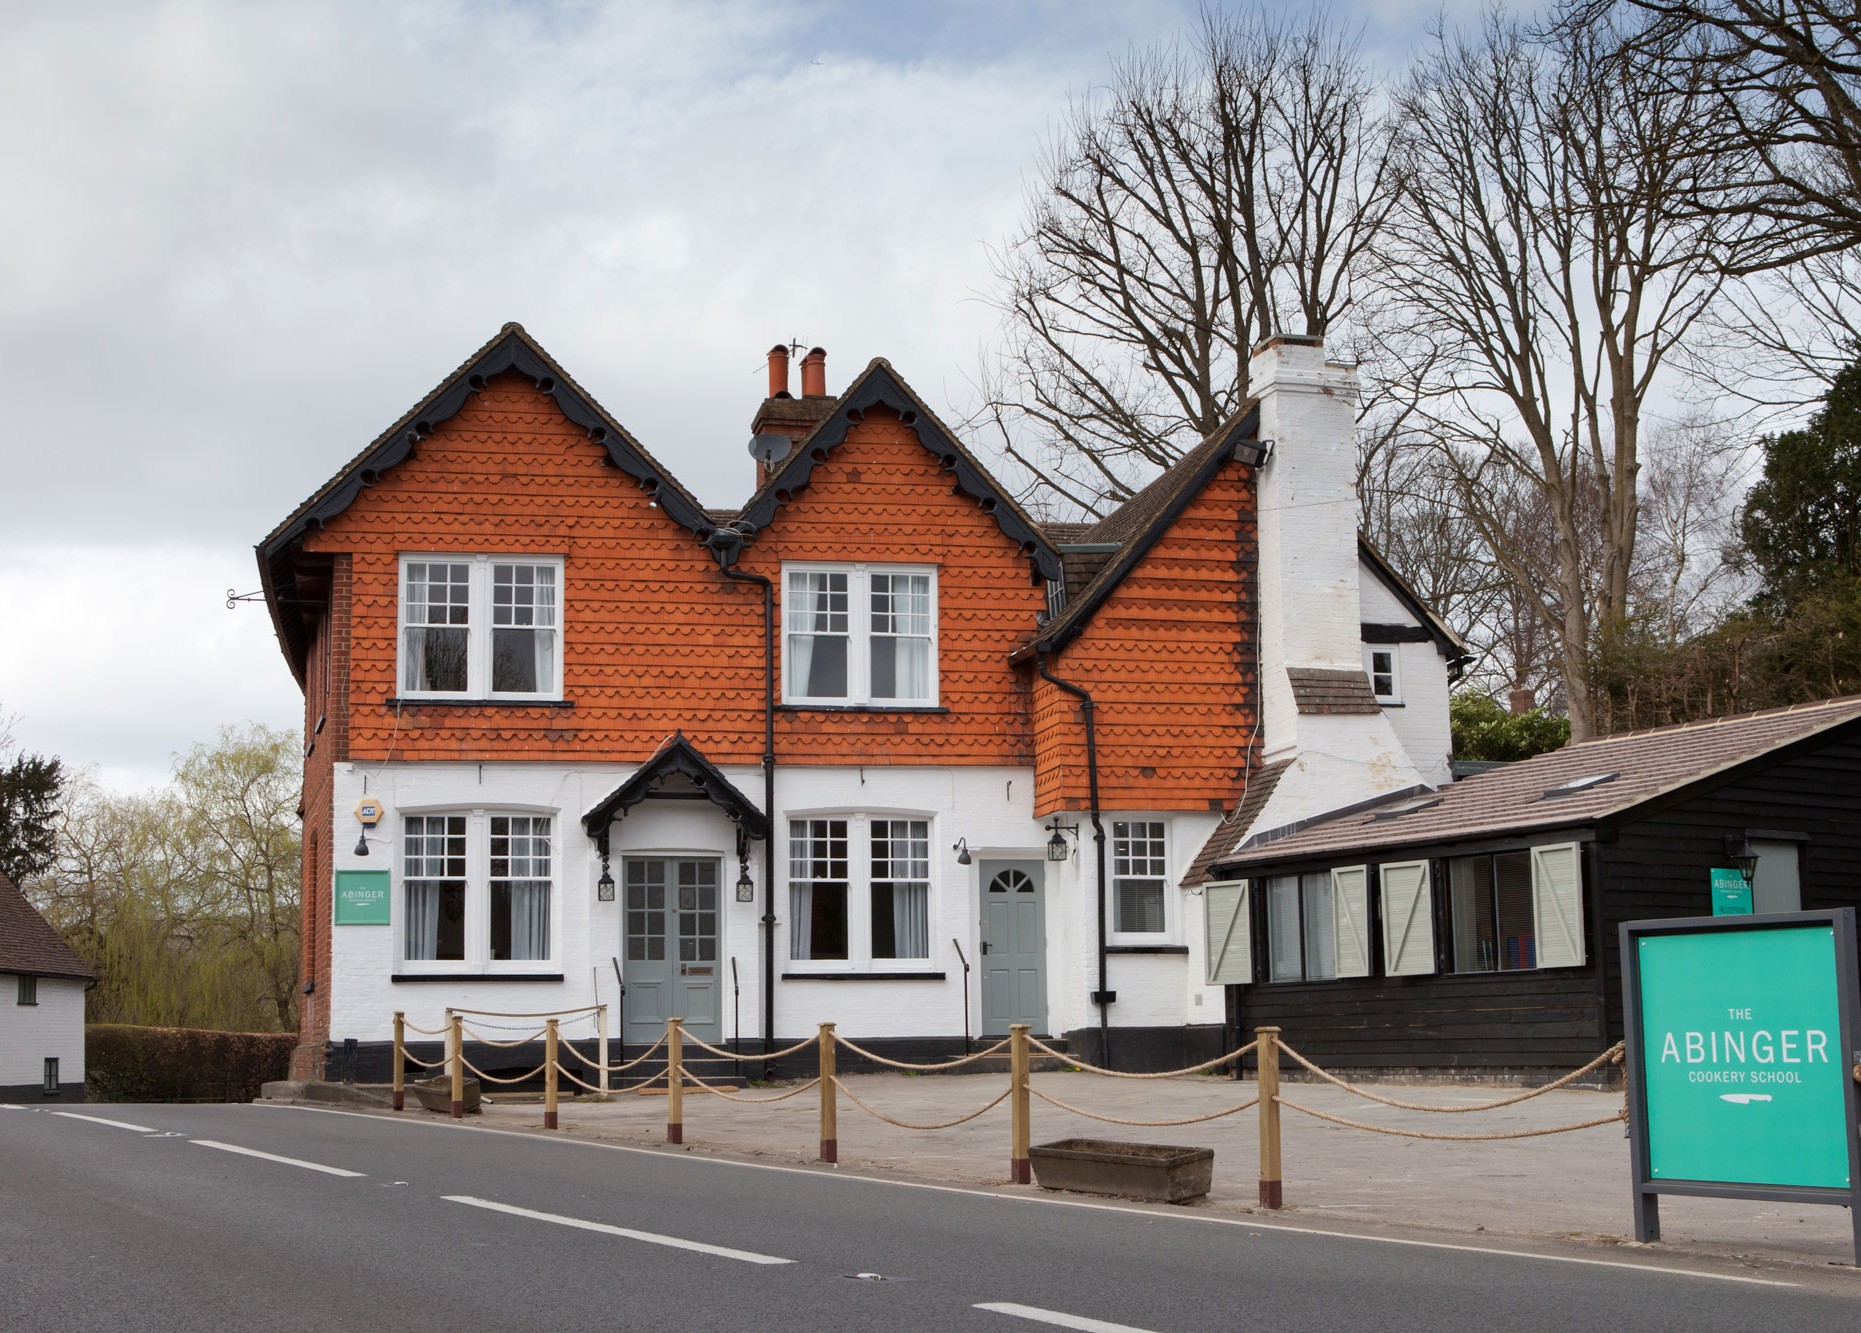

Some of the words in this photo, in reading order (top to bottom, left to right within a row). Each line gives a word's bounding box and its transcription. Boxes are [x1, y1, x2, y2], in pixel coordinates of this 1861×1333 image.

[362, 807, 375, 815] ADT
[341, 890, 384, 899] ABINGER
[1728, 1008, 1752, 1020] THE
[1661, 1030, 1829, 1064] ABINGER
[1688, 1071, 1746, 1083] COOKERY
[1750, 1071, 1802, 1083] SCHOOL
